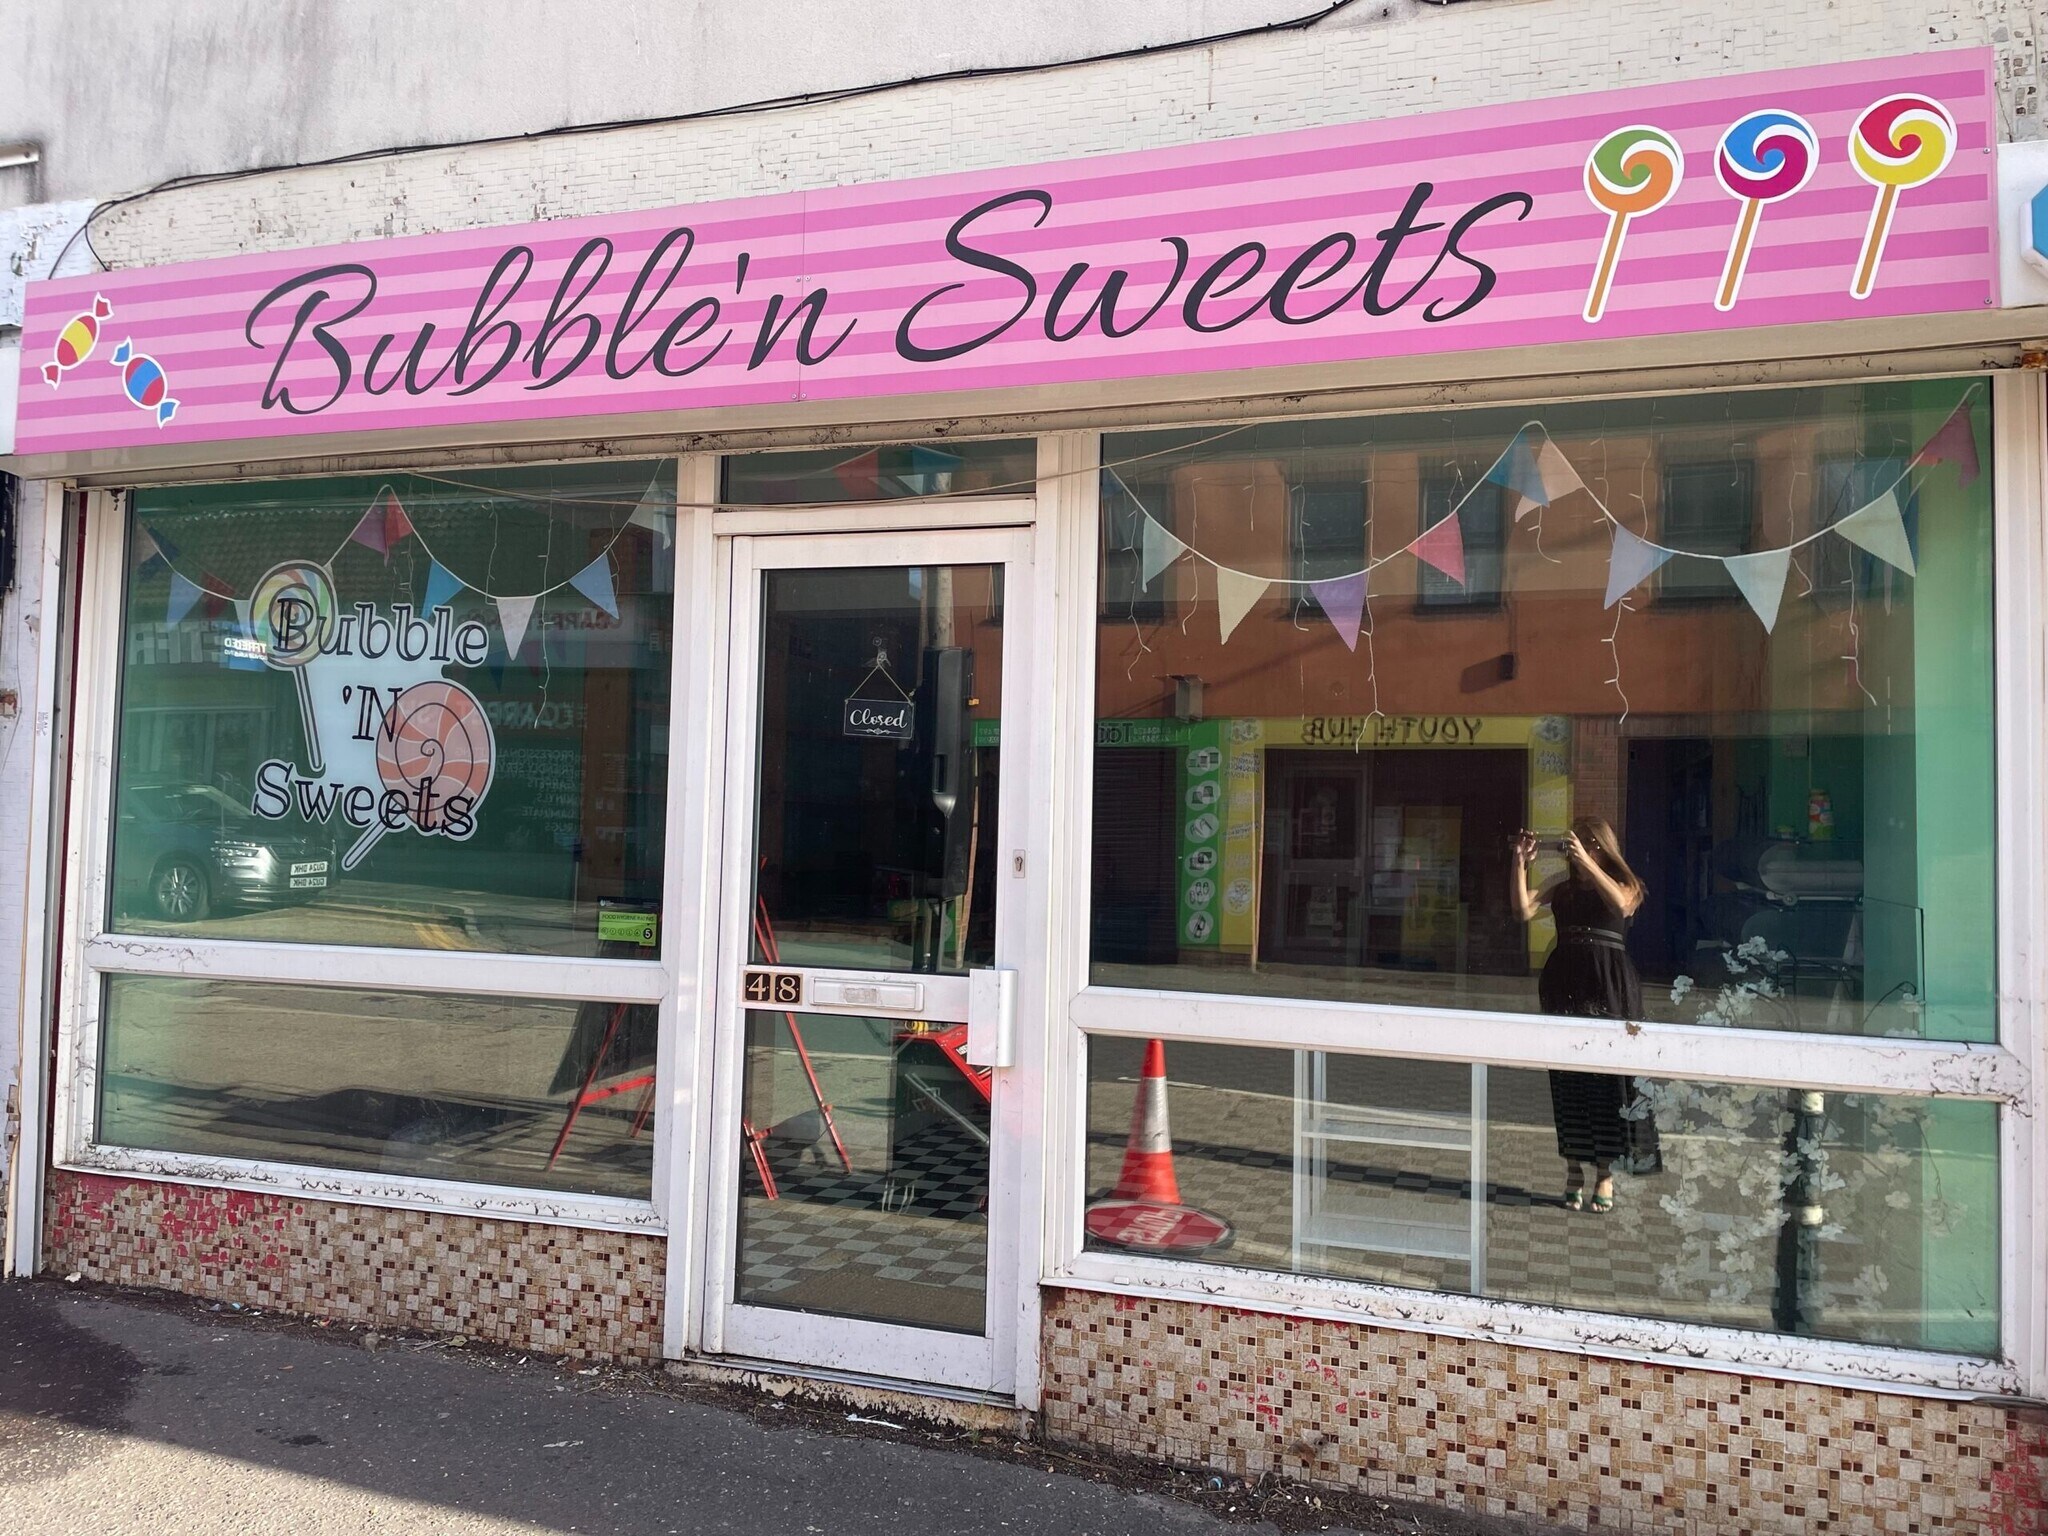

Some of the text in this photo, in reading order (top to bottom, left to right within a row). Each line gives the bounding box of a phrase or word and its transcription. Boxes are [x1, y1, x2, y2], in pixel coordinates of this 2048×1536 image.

[245, 182, 1534, 415] Bubble'n Sweets
[273, 597, 488, 665] Bubble
[342, 684, 404, 742] 'N
[850, 708, 908, 728] Closed
[253, 762, 478, 838] Sweets
[746, 973, 797, 1000] 48
